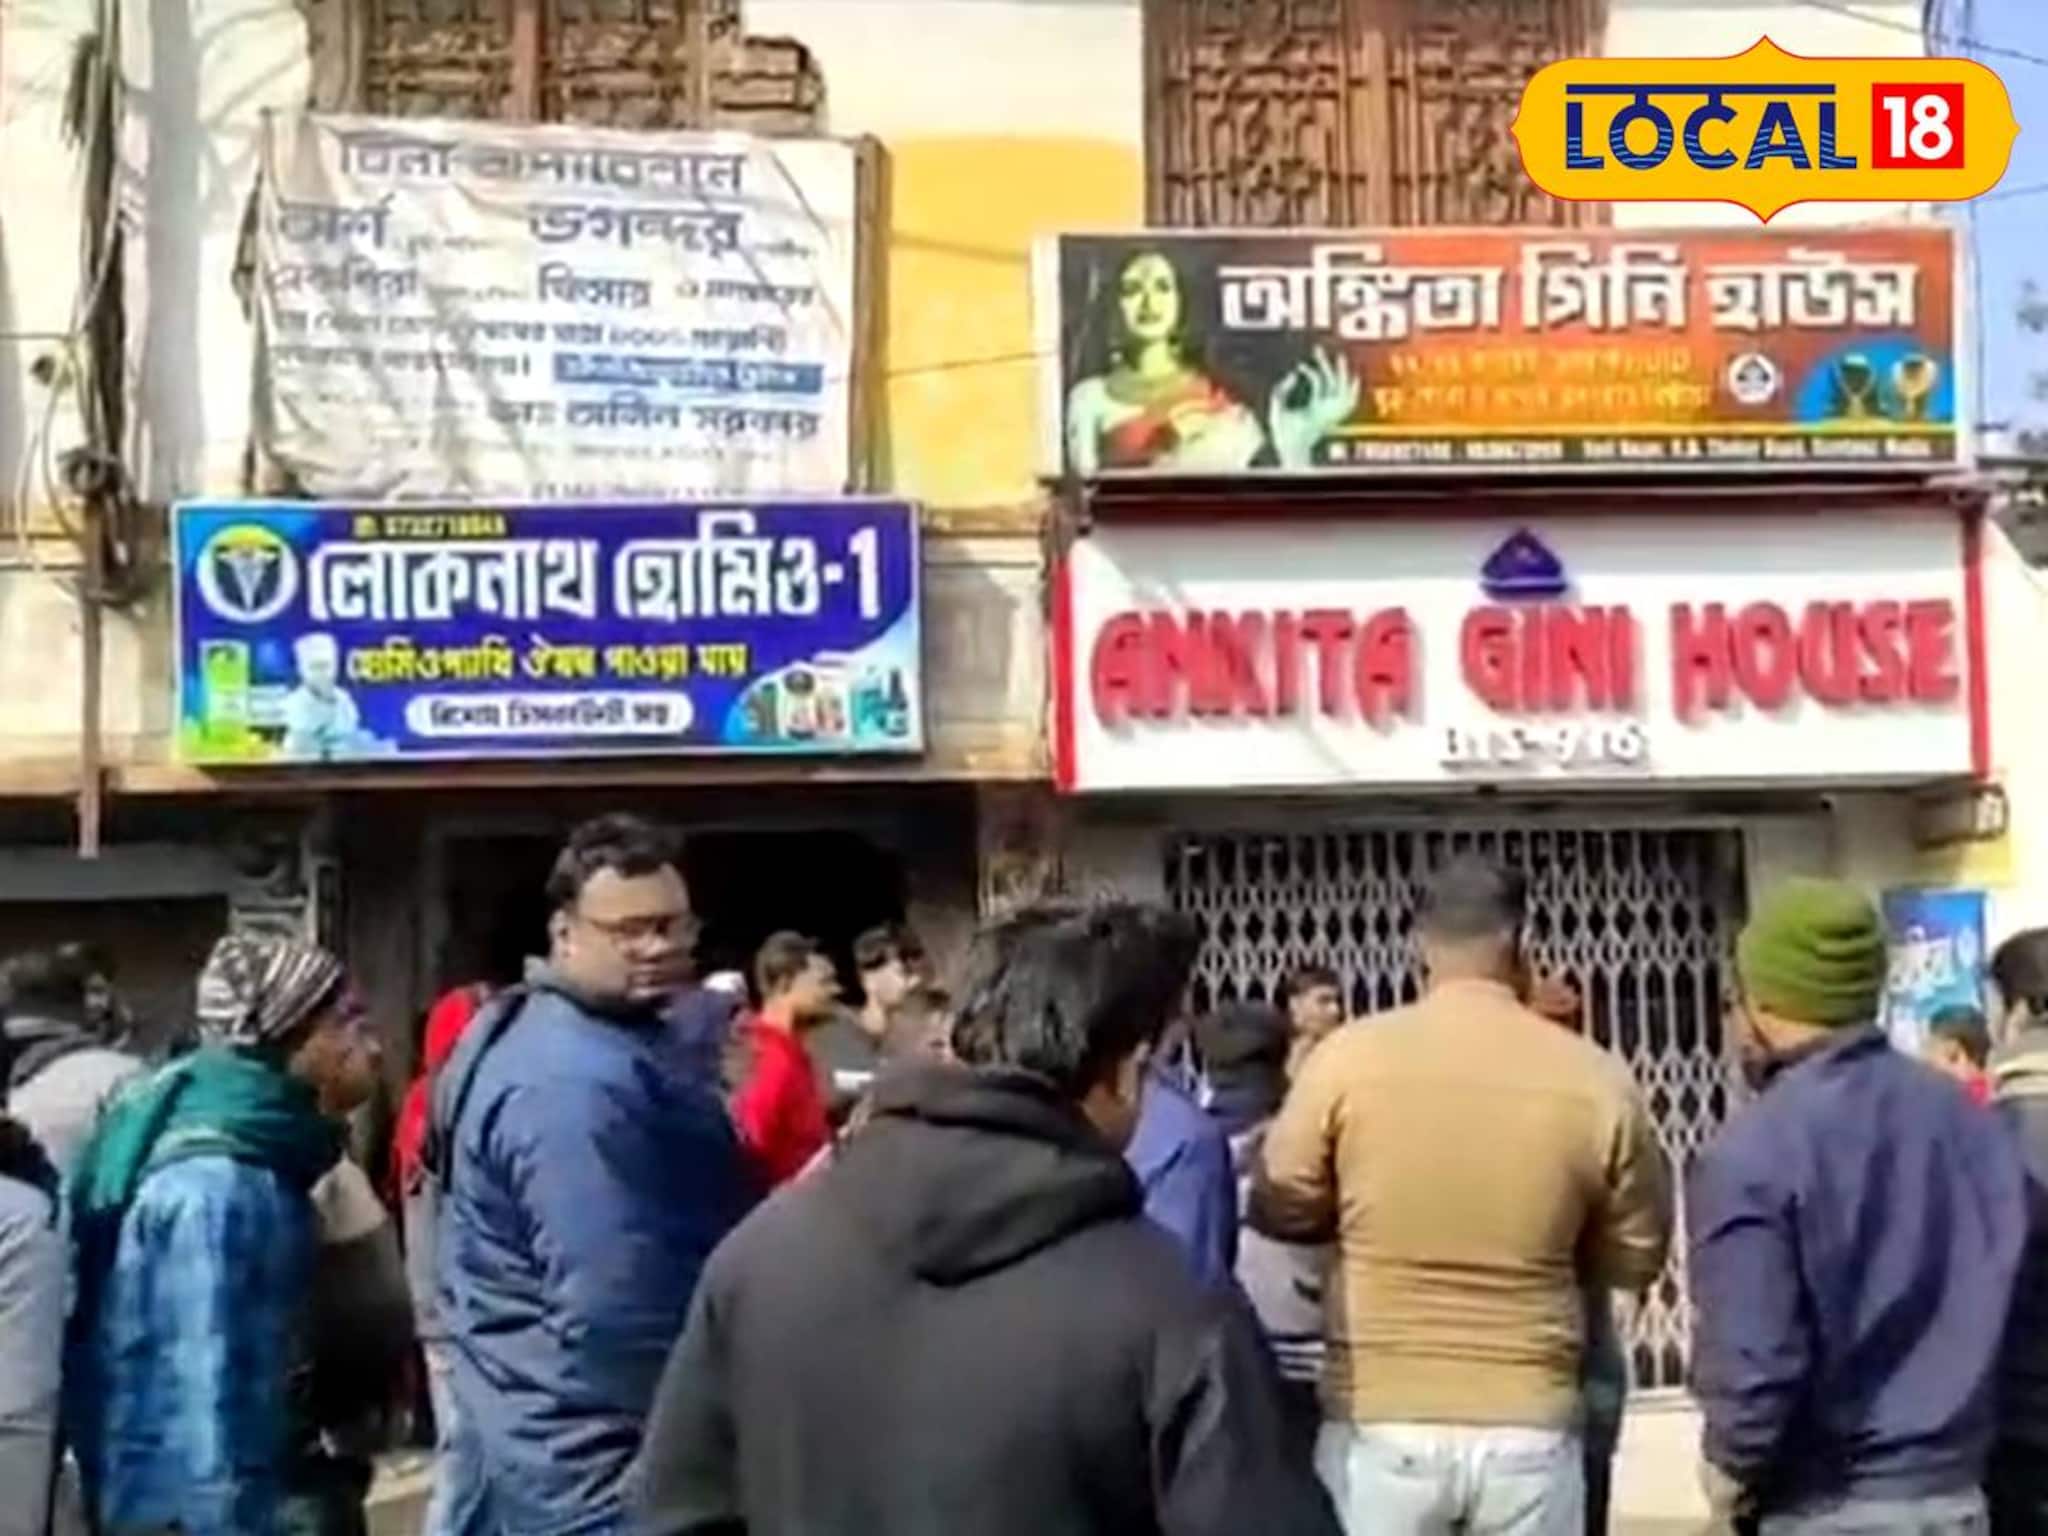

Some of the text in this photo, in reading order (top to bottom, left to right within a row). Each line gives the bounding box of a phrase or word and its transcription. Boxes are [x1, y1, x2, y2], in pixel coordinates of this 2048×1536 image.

[1218, 243, 1918, 341] অঙ্কিতা গিনি হাউস
[306, 534, 598, 621] লোকনাথ
[1090, 599, 1960, 732] ANKITA GINI HOUSE
